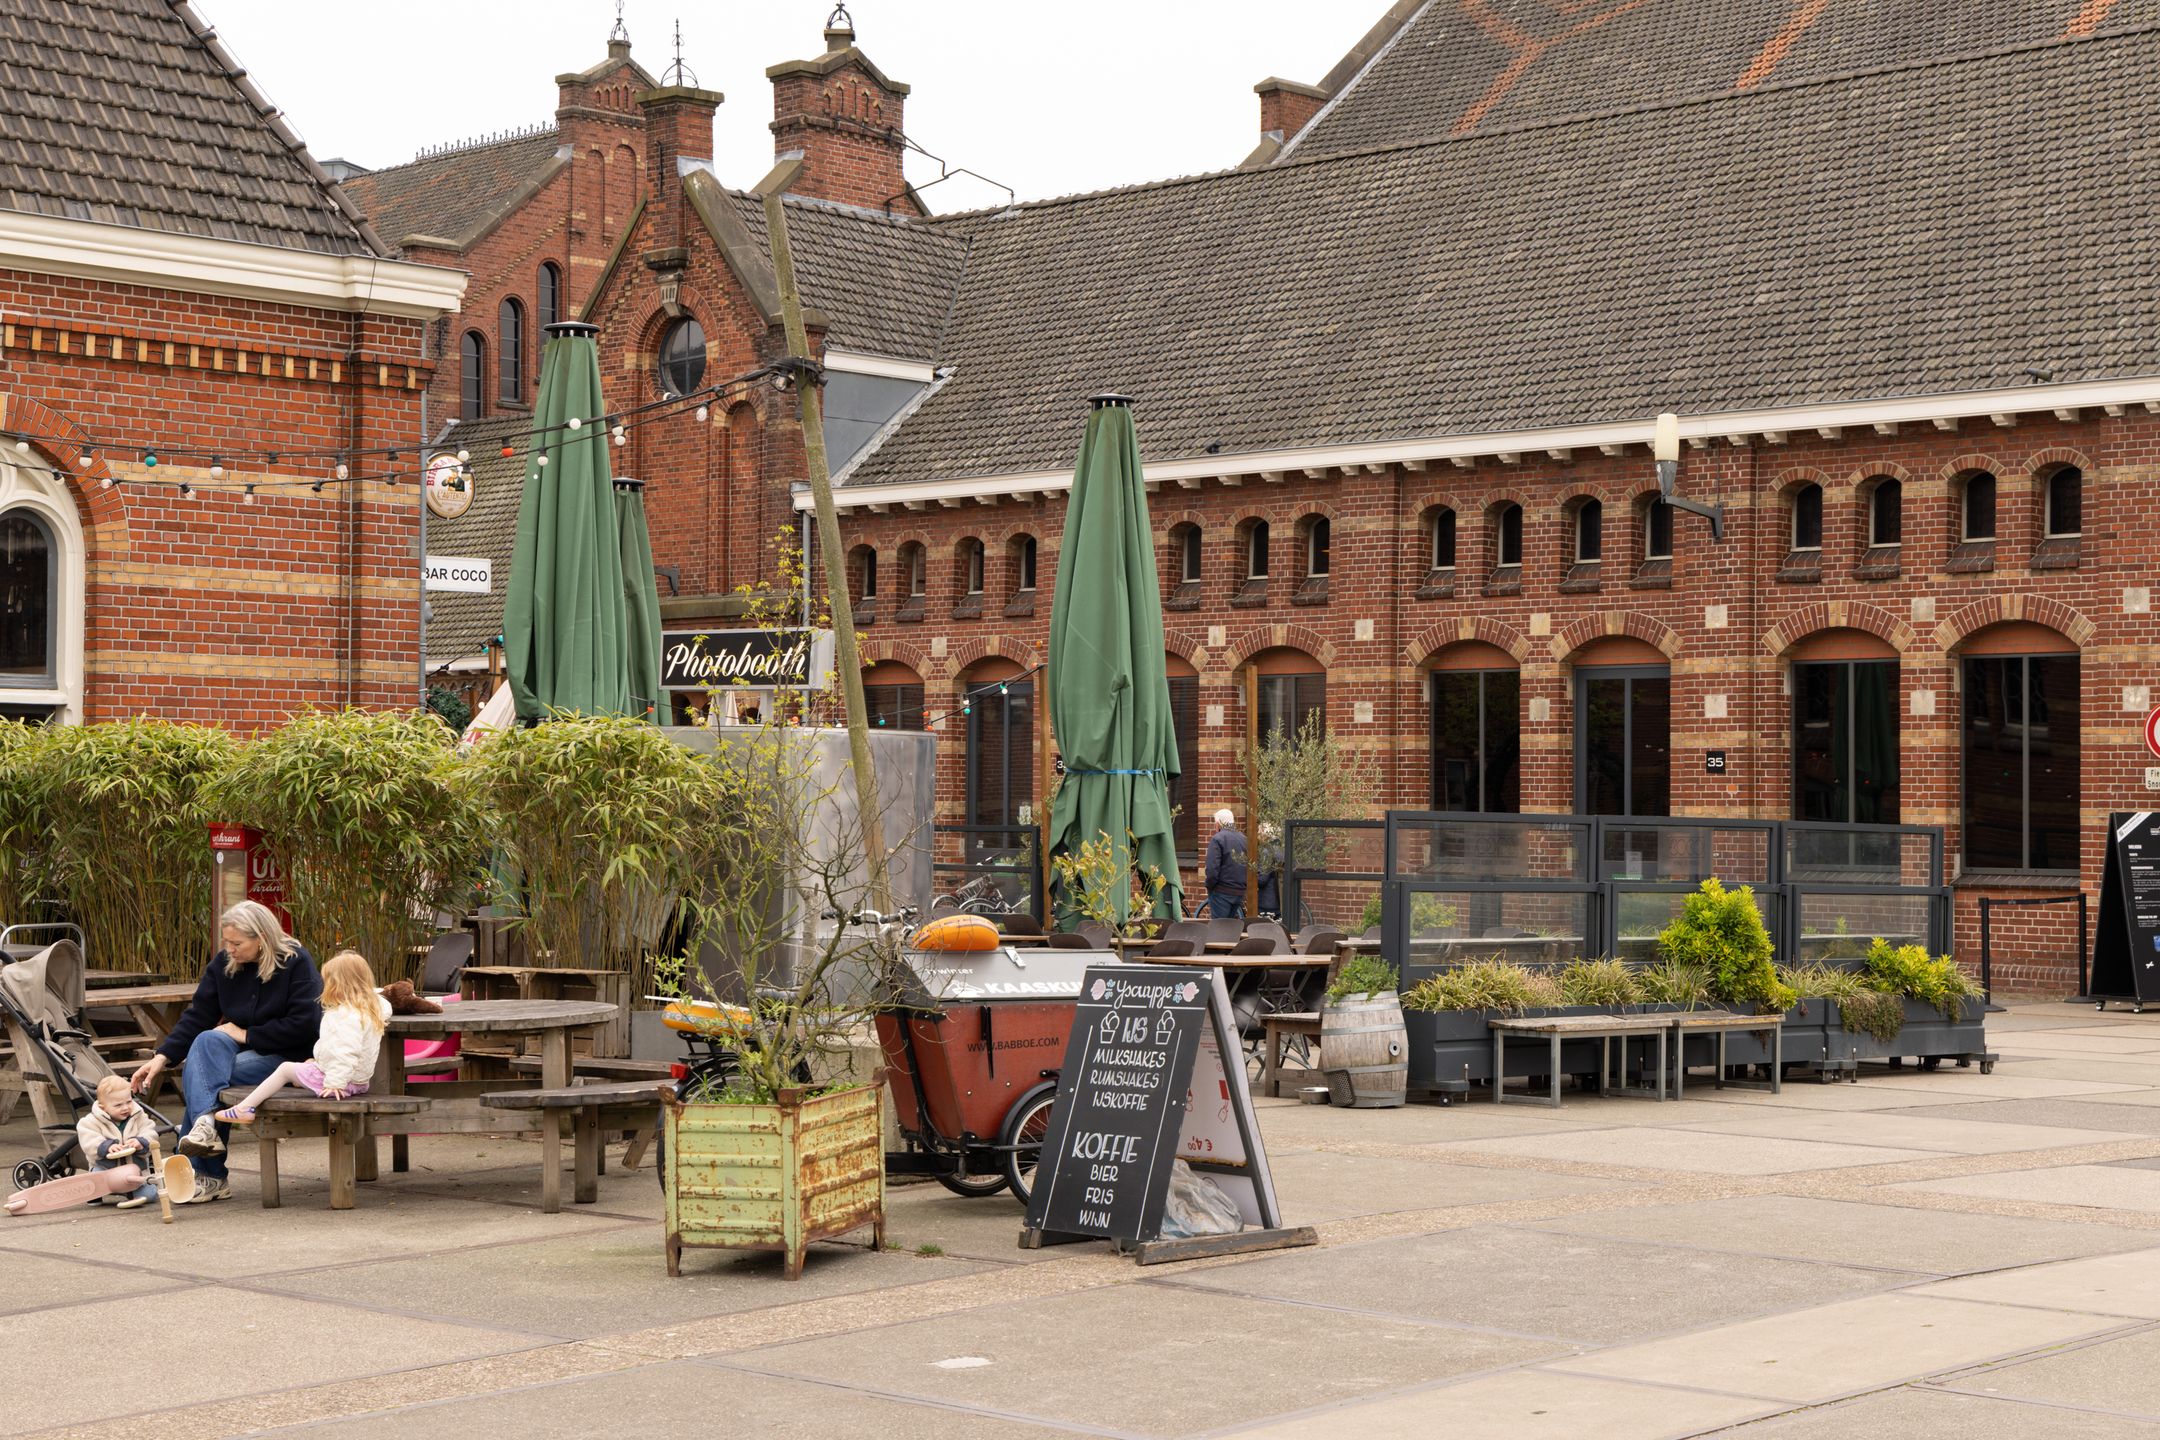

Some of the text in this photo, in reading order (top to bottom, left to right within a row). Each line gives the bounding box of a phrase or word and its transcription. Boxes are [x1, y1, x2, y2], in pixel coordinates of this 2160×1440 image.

[451, 569, 488, 582] COCO
[666, 641, 806, 680] Photobooth
[1707, 757, 1724, 767] 35
[984, 982, 1083, 994] KAASKU
[1121, 1016, 1148, 1043] IJS
[1092, 1048, 1167, 1068] MILKSHAKES
[1089, 1069, 1160, 1088] RUMSHAKES
[1092, 1091, 1150, 1111] IJSKOFFIE
[1071, 1131, 1142, 1163] KOFFIE
[1090, 1165, 1118, 1182] BIER
[1084, 1187, 1114, 1205] FRIS
[1078, 1209, 1111, 1228] WIJN
